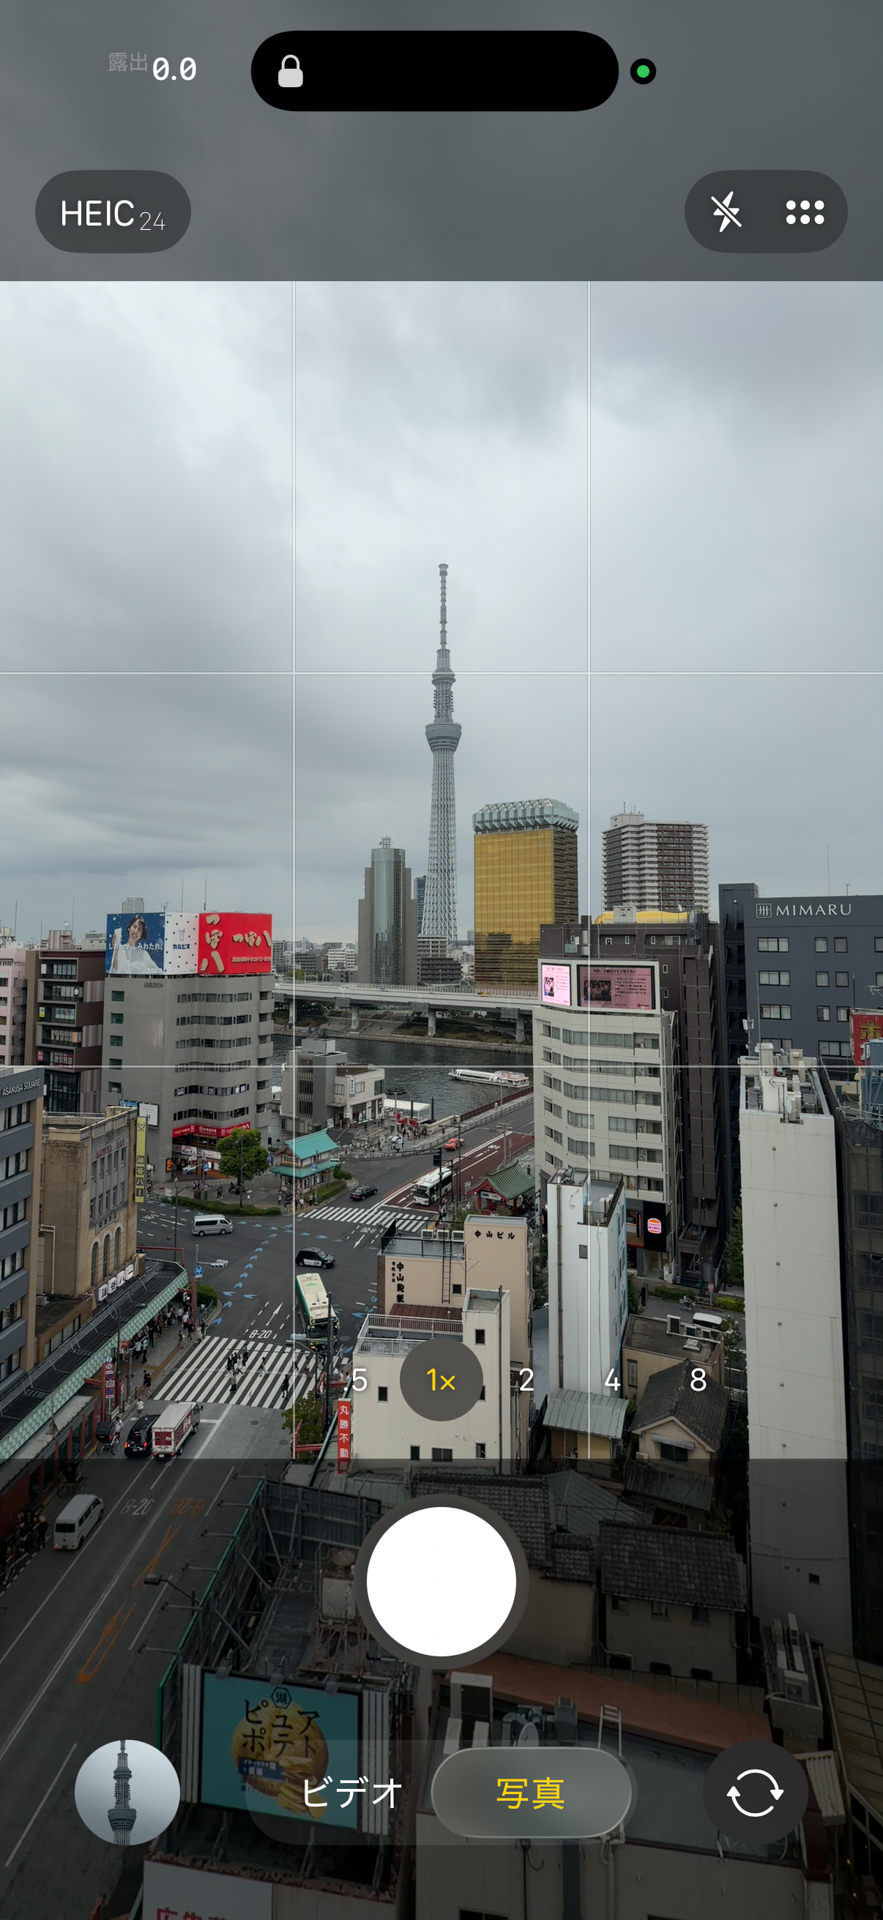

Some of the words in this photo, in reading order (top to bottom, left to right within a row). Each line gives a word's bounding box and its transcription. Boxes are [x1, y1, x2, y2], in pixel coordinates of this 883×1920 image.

[776, 903, 852, 917] MIMARU
[1, 1083, 24, 1097] ASAKUSA
[23, 1078, 41, 1091] SQUARE
[474, 1230, 516, 1240] 中山ビル
[249, 1329, 273, 1339] 8-20
[120, 1498, 155, 1516] 8-20
[244, 1698, 320, 1735] ピュア
[242, 1727, 316, 1759] ポテト
